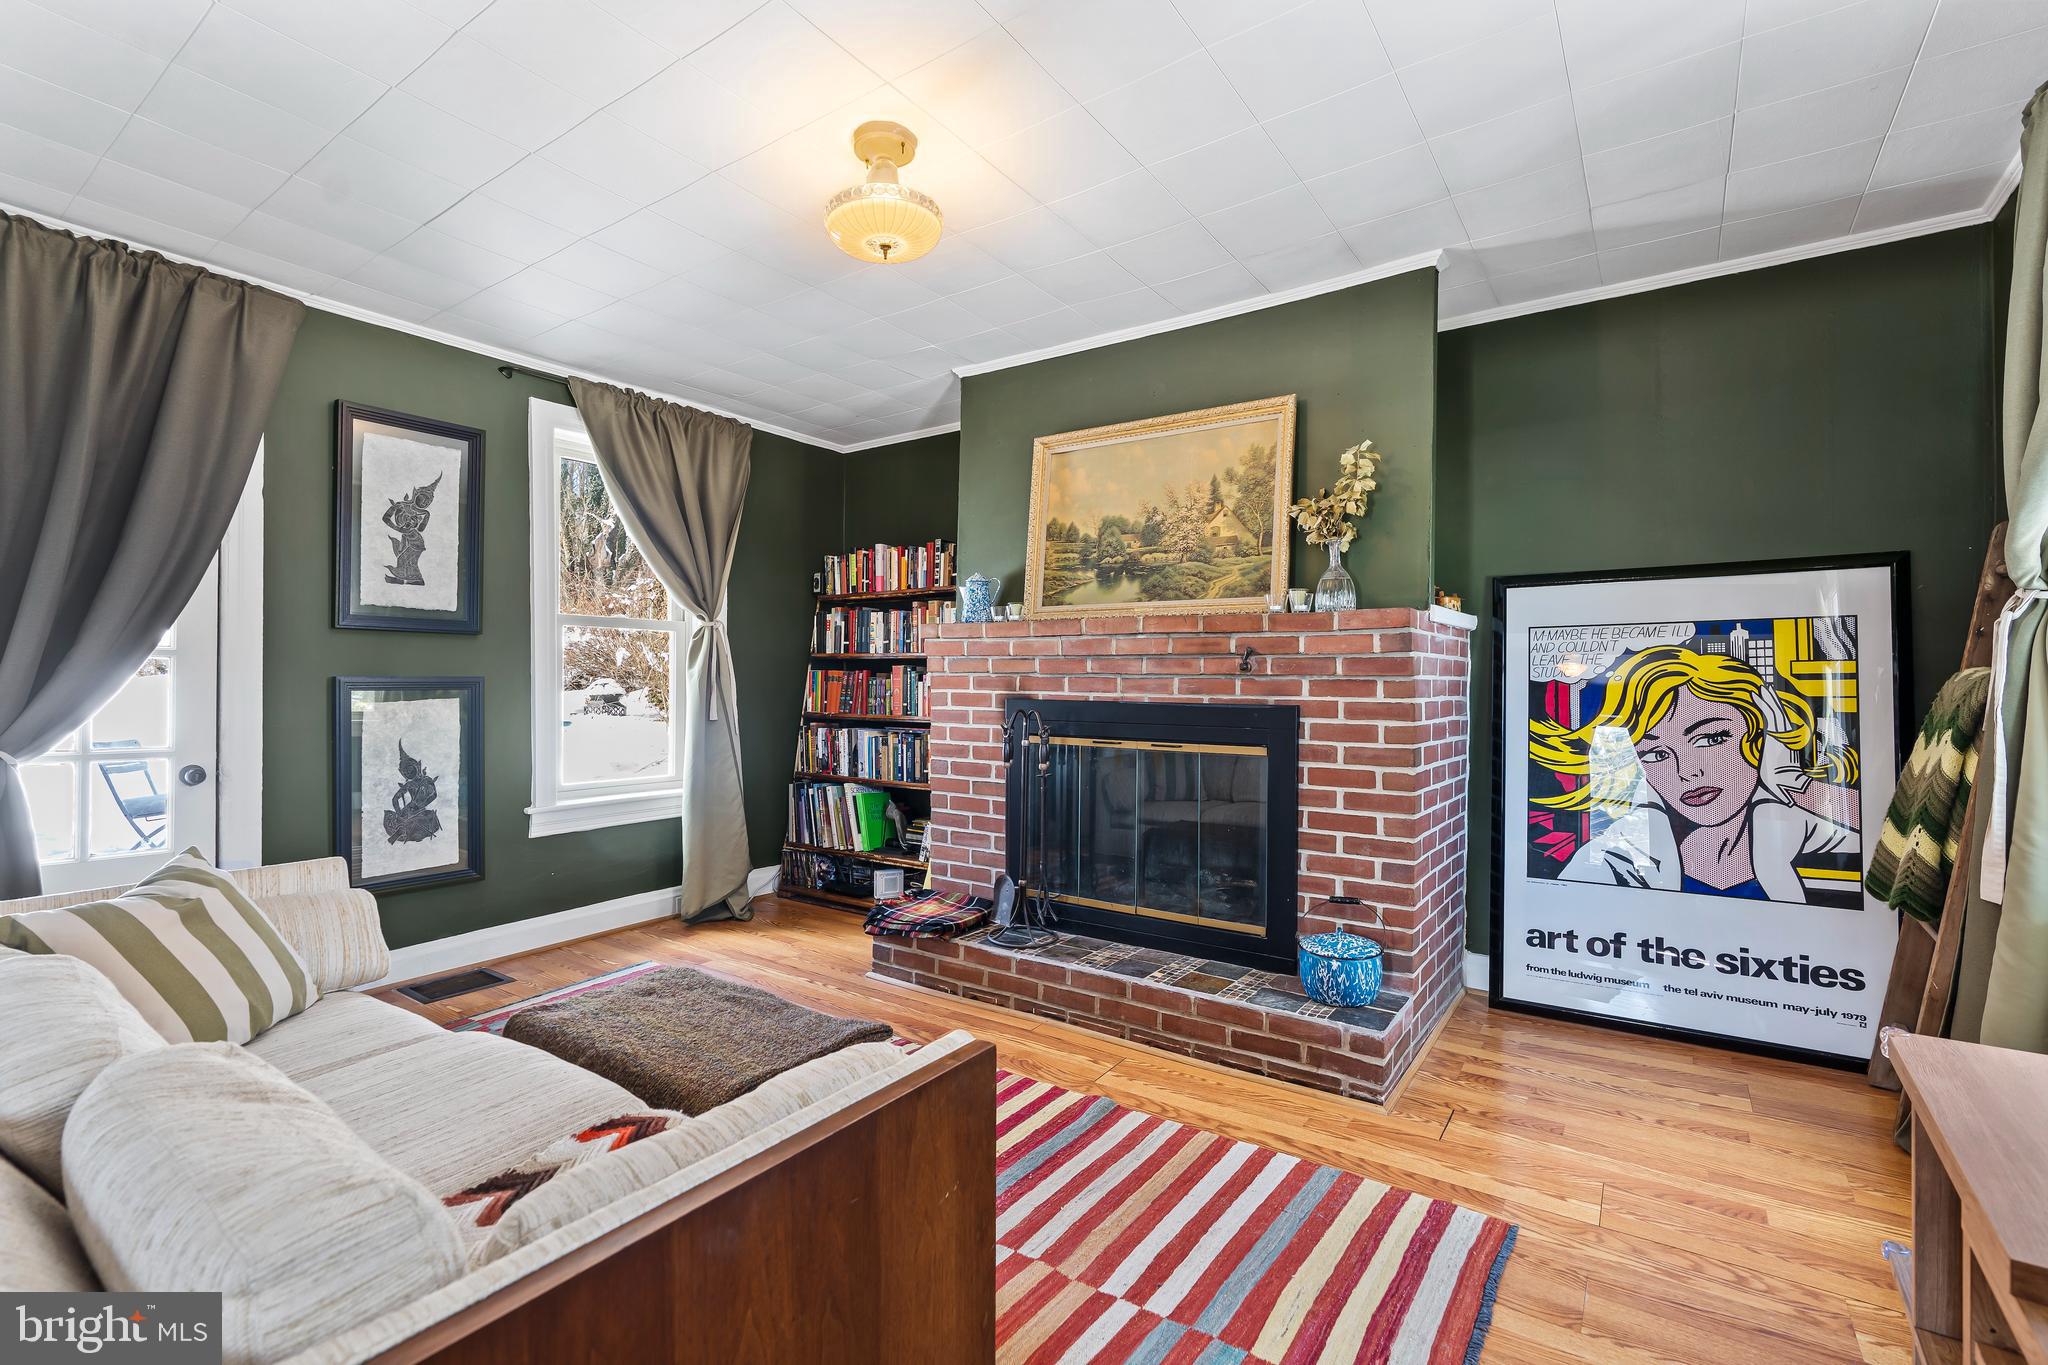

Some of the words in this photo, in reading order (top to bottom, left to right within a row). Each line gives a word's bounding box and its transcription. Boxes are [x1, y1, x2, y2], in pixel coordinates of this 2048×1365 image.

[1591, 628, 1610, 640] HE
[1611, 625, 1669, 639] BECAME
[1671, 625, 1692, 637] ILL
[1531, 642, 1555, 653] AND
[1580, 653, 1604, 665] THE
[1526, 928, 1579, 953] art
[1586, 932, 1627, 959] of
[1637, 936, 1706, 970] the
[1715, 947, 1866, 992] sixties
[1526, 963, 1549, 974] from
[1551, 967, 1567, 977] the
[1568, 969, 1602, 983] ludwig
[1604, 976, 1650, 989] museum
[1663, 984, 1682, 994] the
[1684, 988, 1698, 997] tel
[1700, 990, 1724, 1001] aviv
[1726, 995, 1778, 1009] museum
[1783, 1003, 1838, 1019] may-july
[1841, 1012, 1867, 1022] 1979
